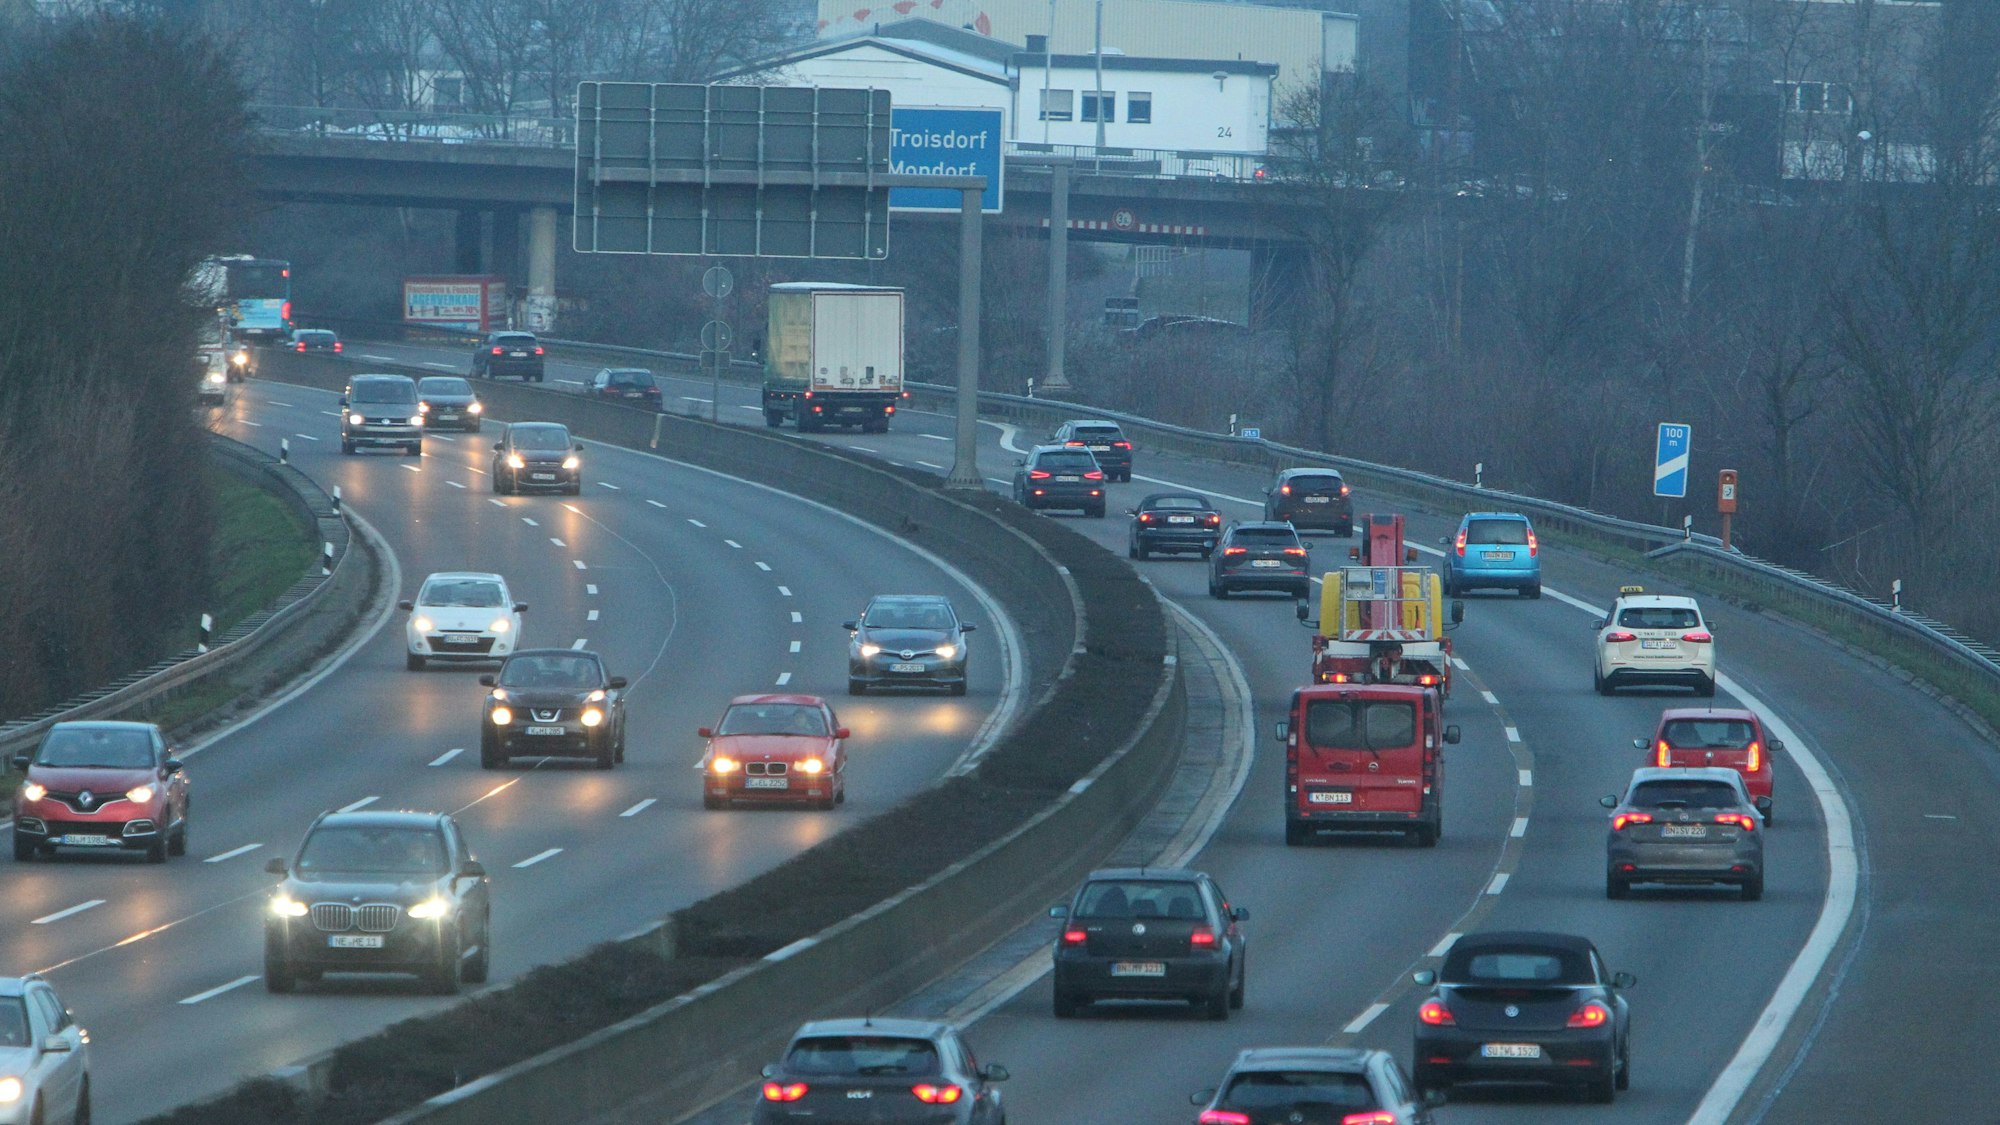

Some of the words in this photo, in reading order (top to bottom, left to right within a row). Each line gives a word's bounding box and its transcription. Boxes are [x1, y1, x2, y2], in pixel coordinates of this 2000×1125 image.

[1217, 126, 1232, 138] 24
[890, 128, 987, 149] Troisdorf
[1666, 428, 1683, 438] 100
